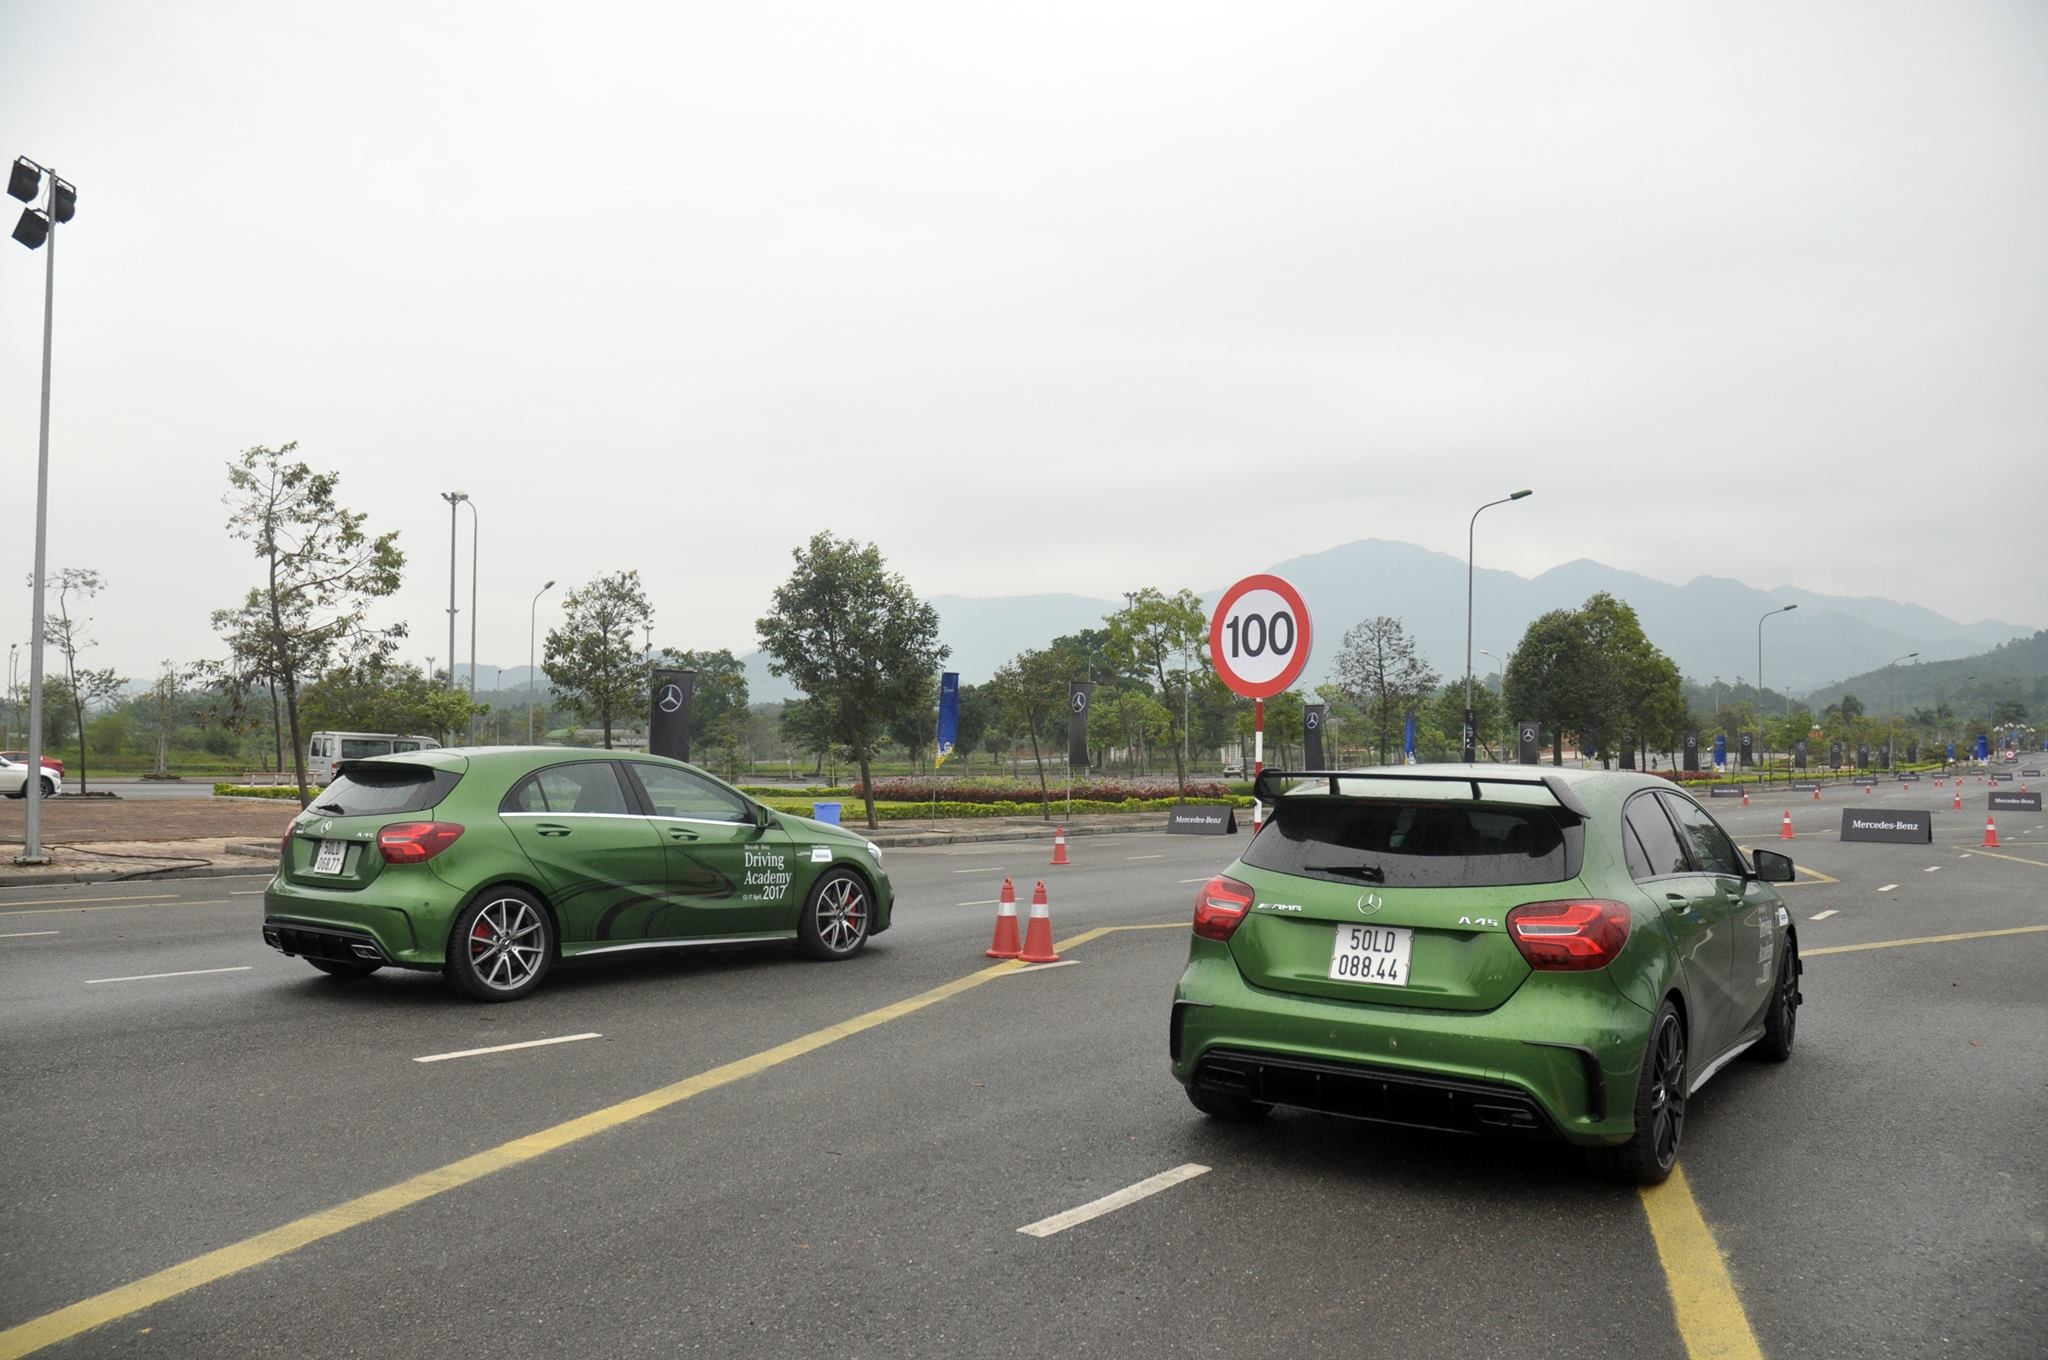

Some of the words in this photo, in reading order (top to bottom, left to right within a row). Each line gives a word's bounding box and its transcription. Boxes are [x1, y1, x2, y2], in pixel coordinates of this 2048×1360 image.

[1226, 611, 1294, 657] 100
[1175, 816, 1222, 824] Mercedes-Benz
[1852, 820, 1919, 831] Mercedes-Benz
[744, 852, 785, 870] Driving
[744, 869, 792, 888] Academy
[763, 885, 787, 900] 2017
[1271, 903, 1302, 911] AMG
[1350, 928, 1396, 953] 50LD
[1338, 954, 1398, 981] 088.44
